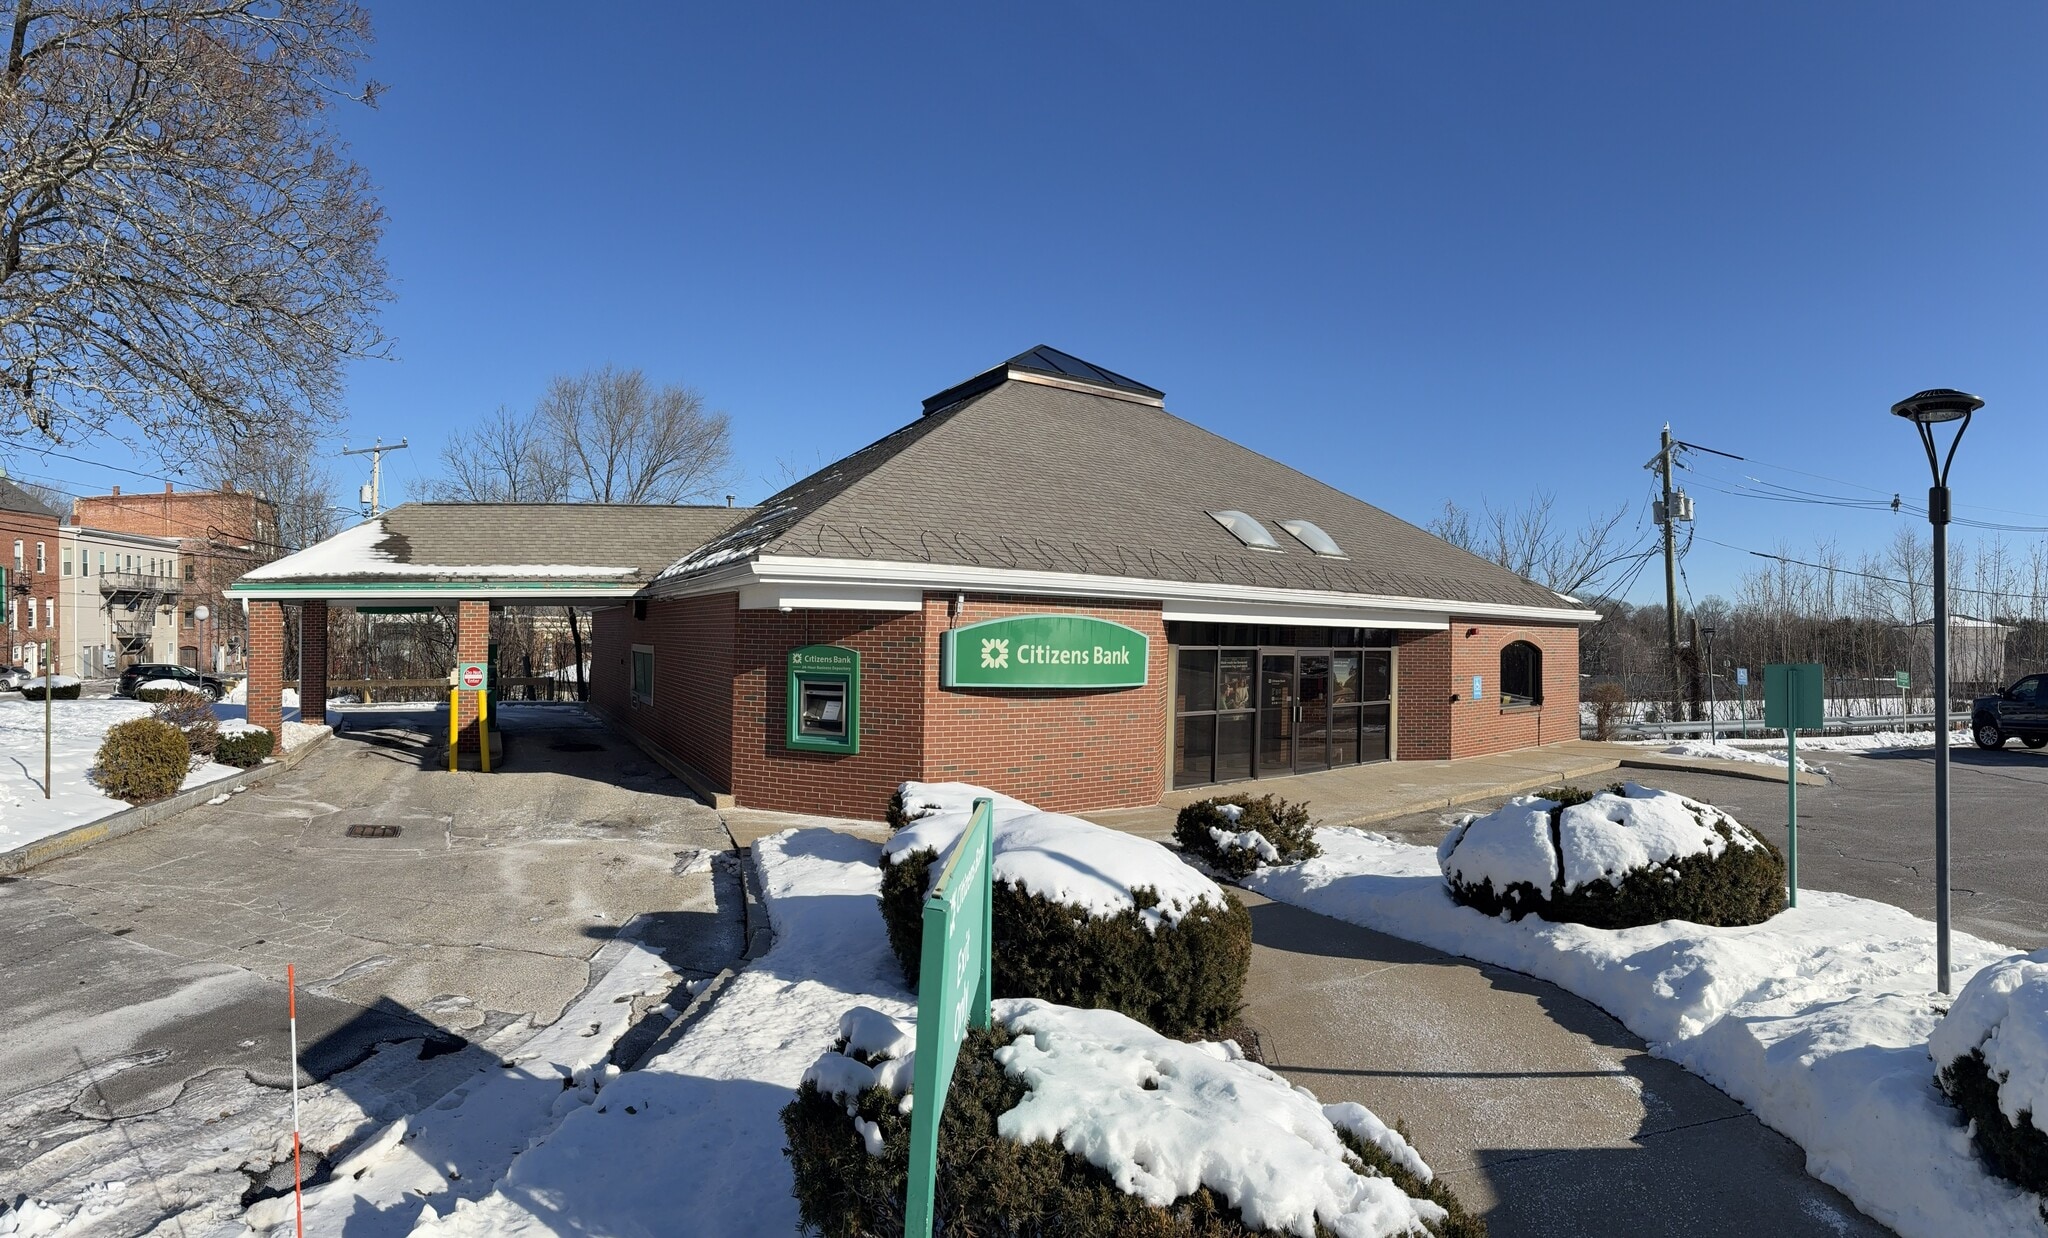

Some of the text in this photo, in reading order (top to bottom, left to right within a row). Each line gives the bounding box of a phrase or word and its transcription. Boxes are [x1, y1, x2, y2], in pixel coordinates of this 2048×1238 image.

[804, 655, 851, 664] Citizens Bank
[1016, 644, 1130, 665] Citizens Bank
